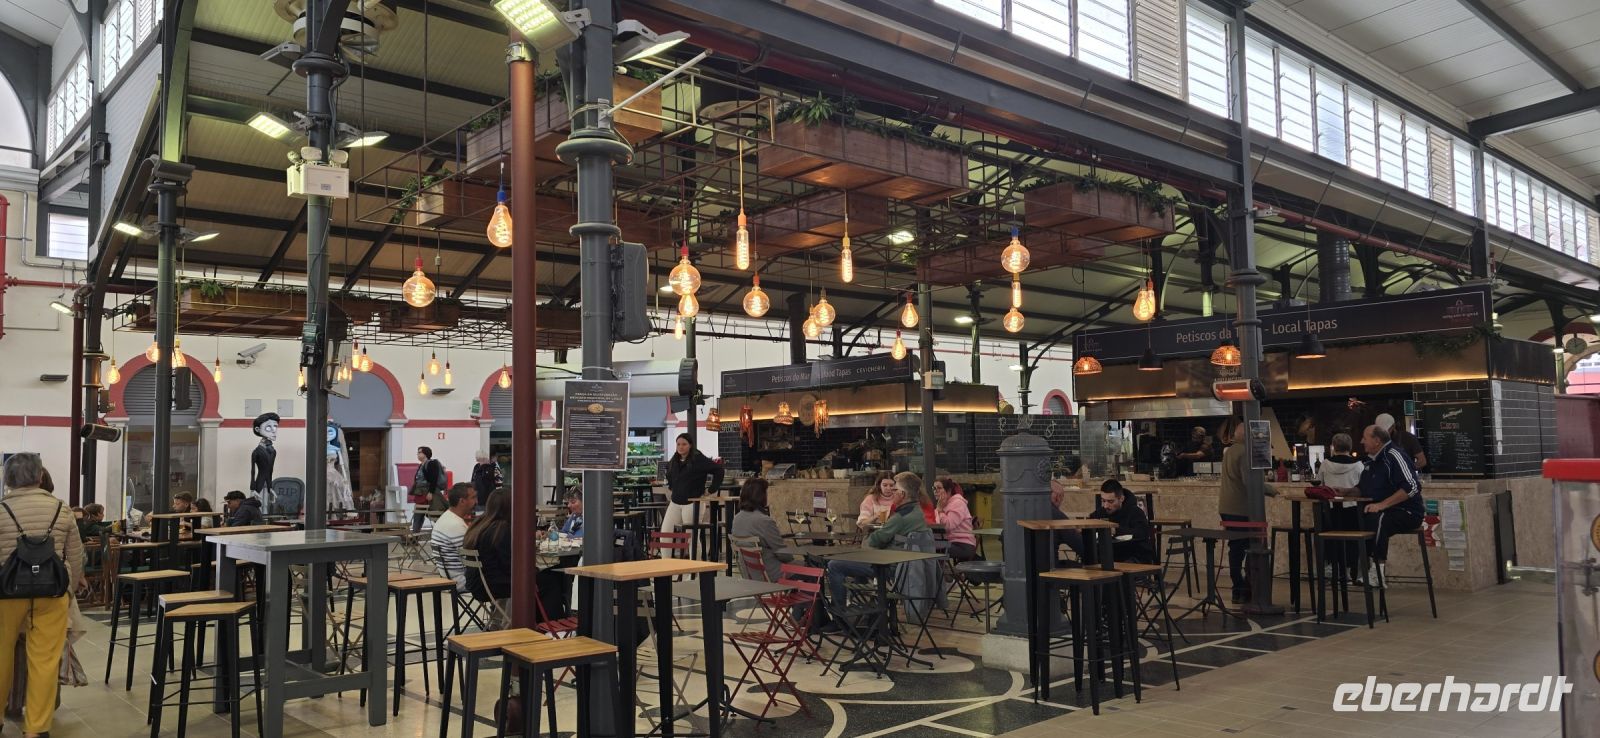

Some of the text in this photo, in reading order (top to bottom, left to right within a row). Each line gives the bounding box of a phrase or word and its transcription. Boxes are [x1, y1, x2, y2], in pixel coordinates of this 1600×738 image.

[1176, 330, 1217, 344] Petiscos
[1219, 328, 1232, 339] da
[1272, 321, 1301, 335] Local
[1304, 318, 1338, 334] Tapas
[836, 367, 852, 378] Tapas
[278, 487, 297, 496] RIP
